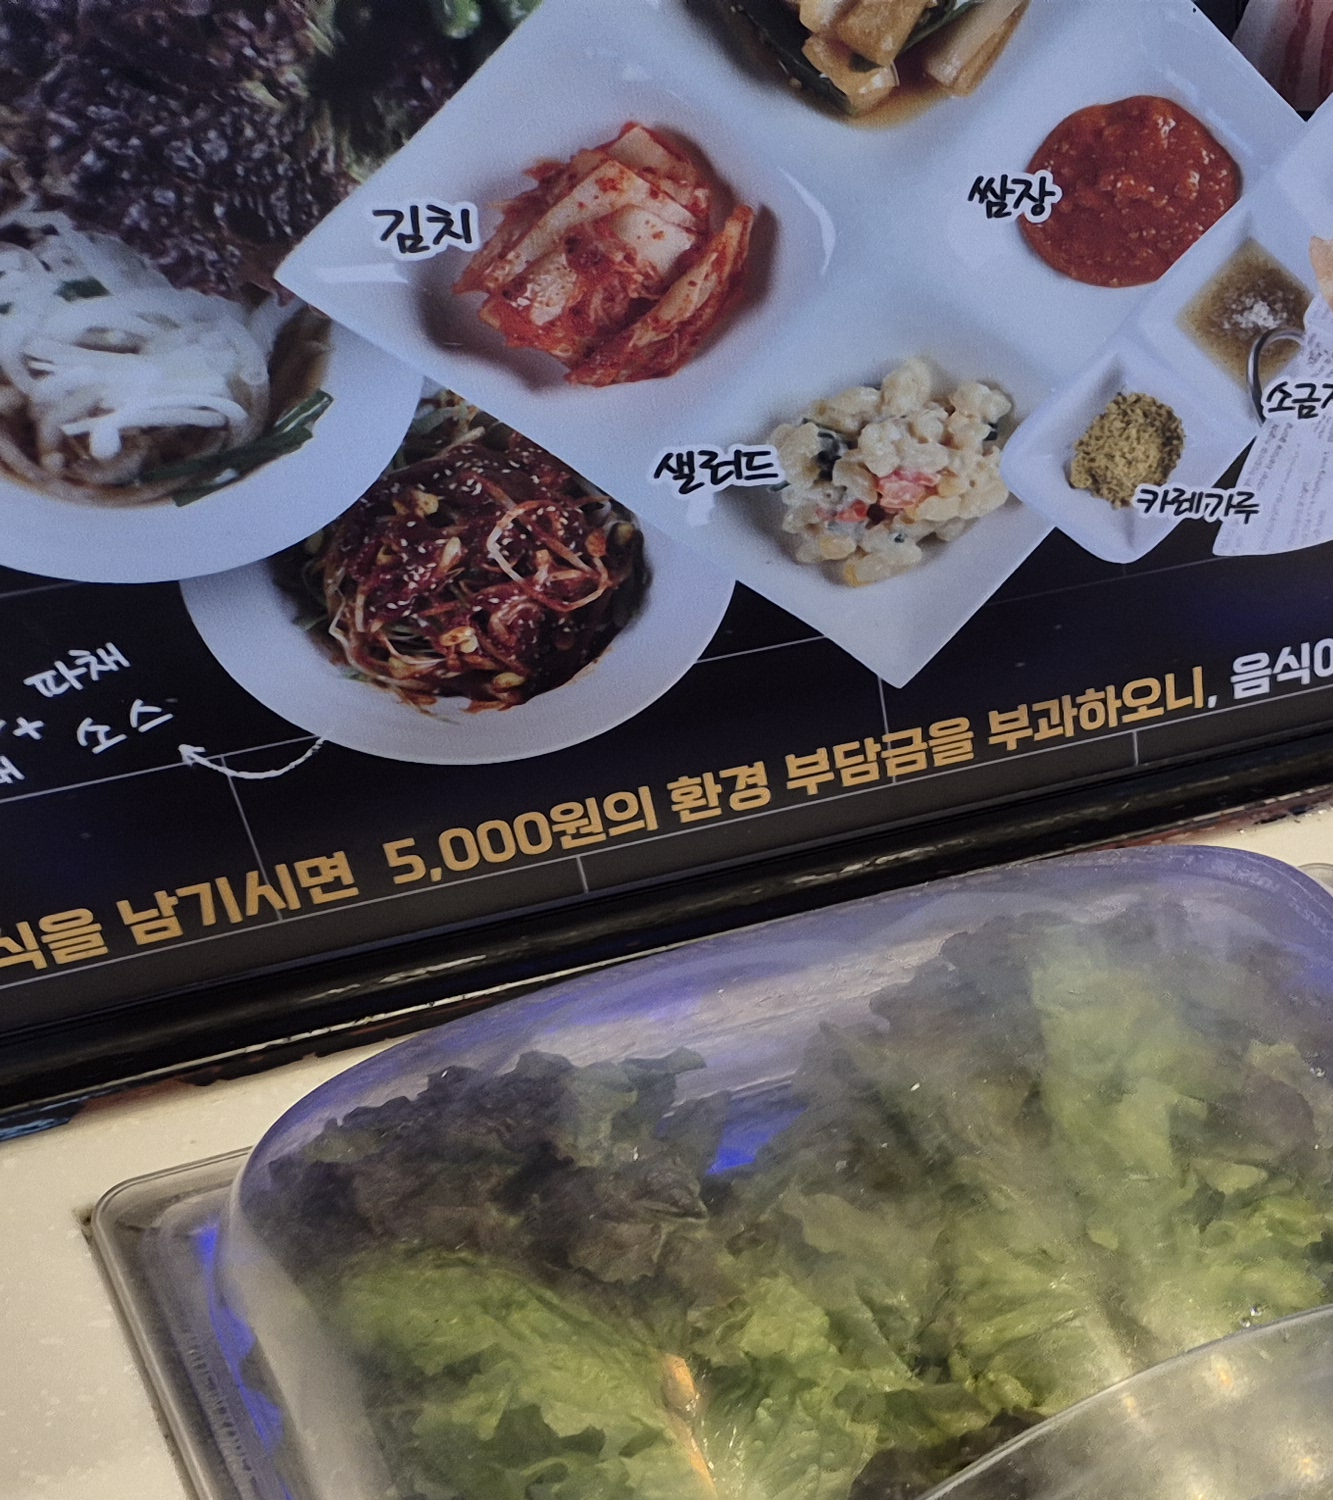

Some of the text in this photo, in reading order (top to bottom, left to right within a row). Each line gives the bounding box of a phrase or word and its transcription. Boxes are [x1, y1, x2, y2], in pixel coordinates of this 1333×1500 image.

[968, 175, 1055, 218] 쌈장
[373, 204, 473, 252] 김치
[652, 449, 781, 492] 샐러드
[1136, 488, 1260, 523] 카레가루
[23, 641, 131, 697] 파채
[116, 850, 359, 945] 남기시면
[382, 787, 657, 883] 5,000원의
[667, 762, 771, 825] 환경
[784, 716, 975, 796] 부담금을
[987, 666, 1219, 752] 부과하오니,
